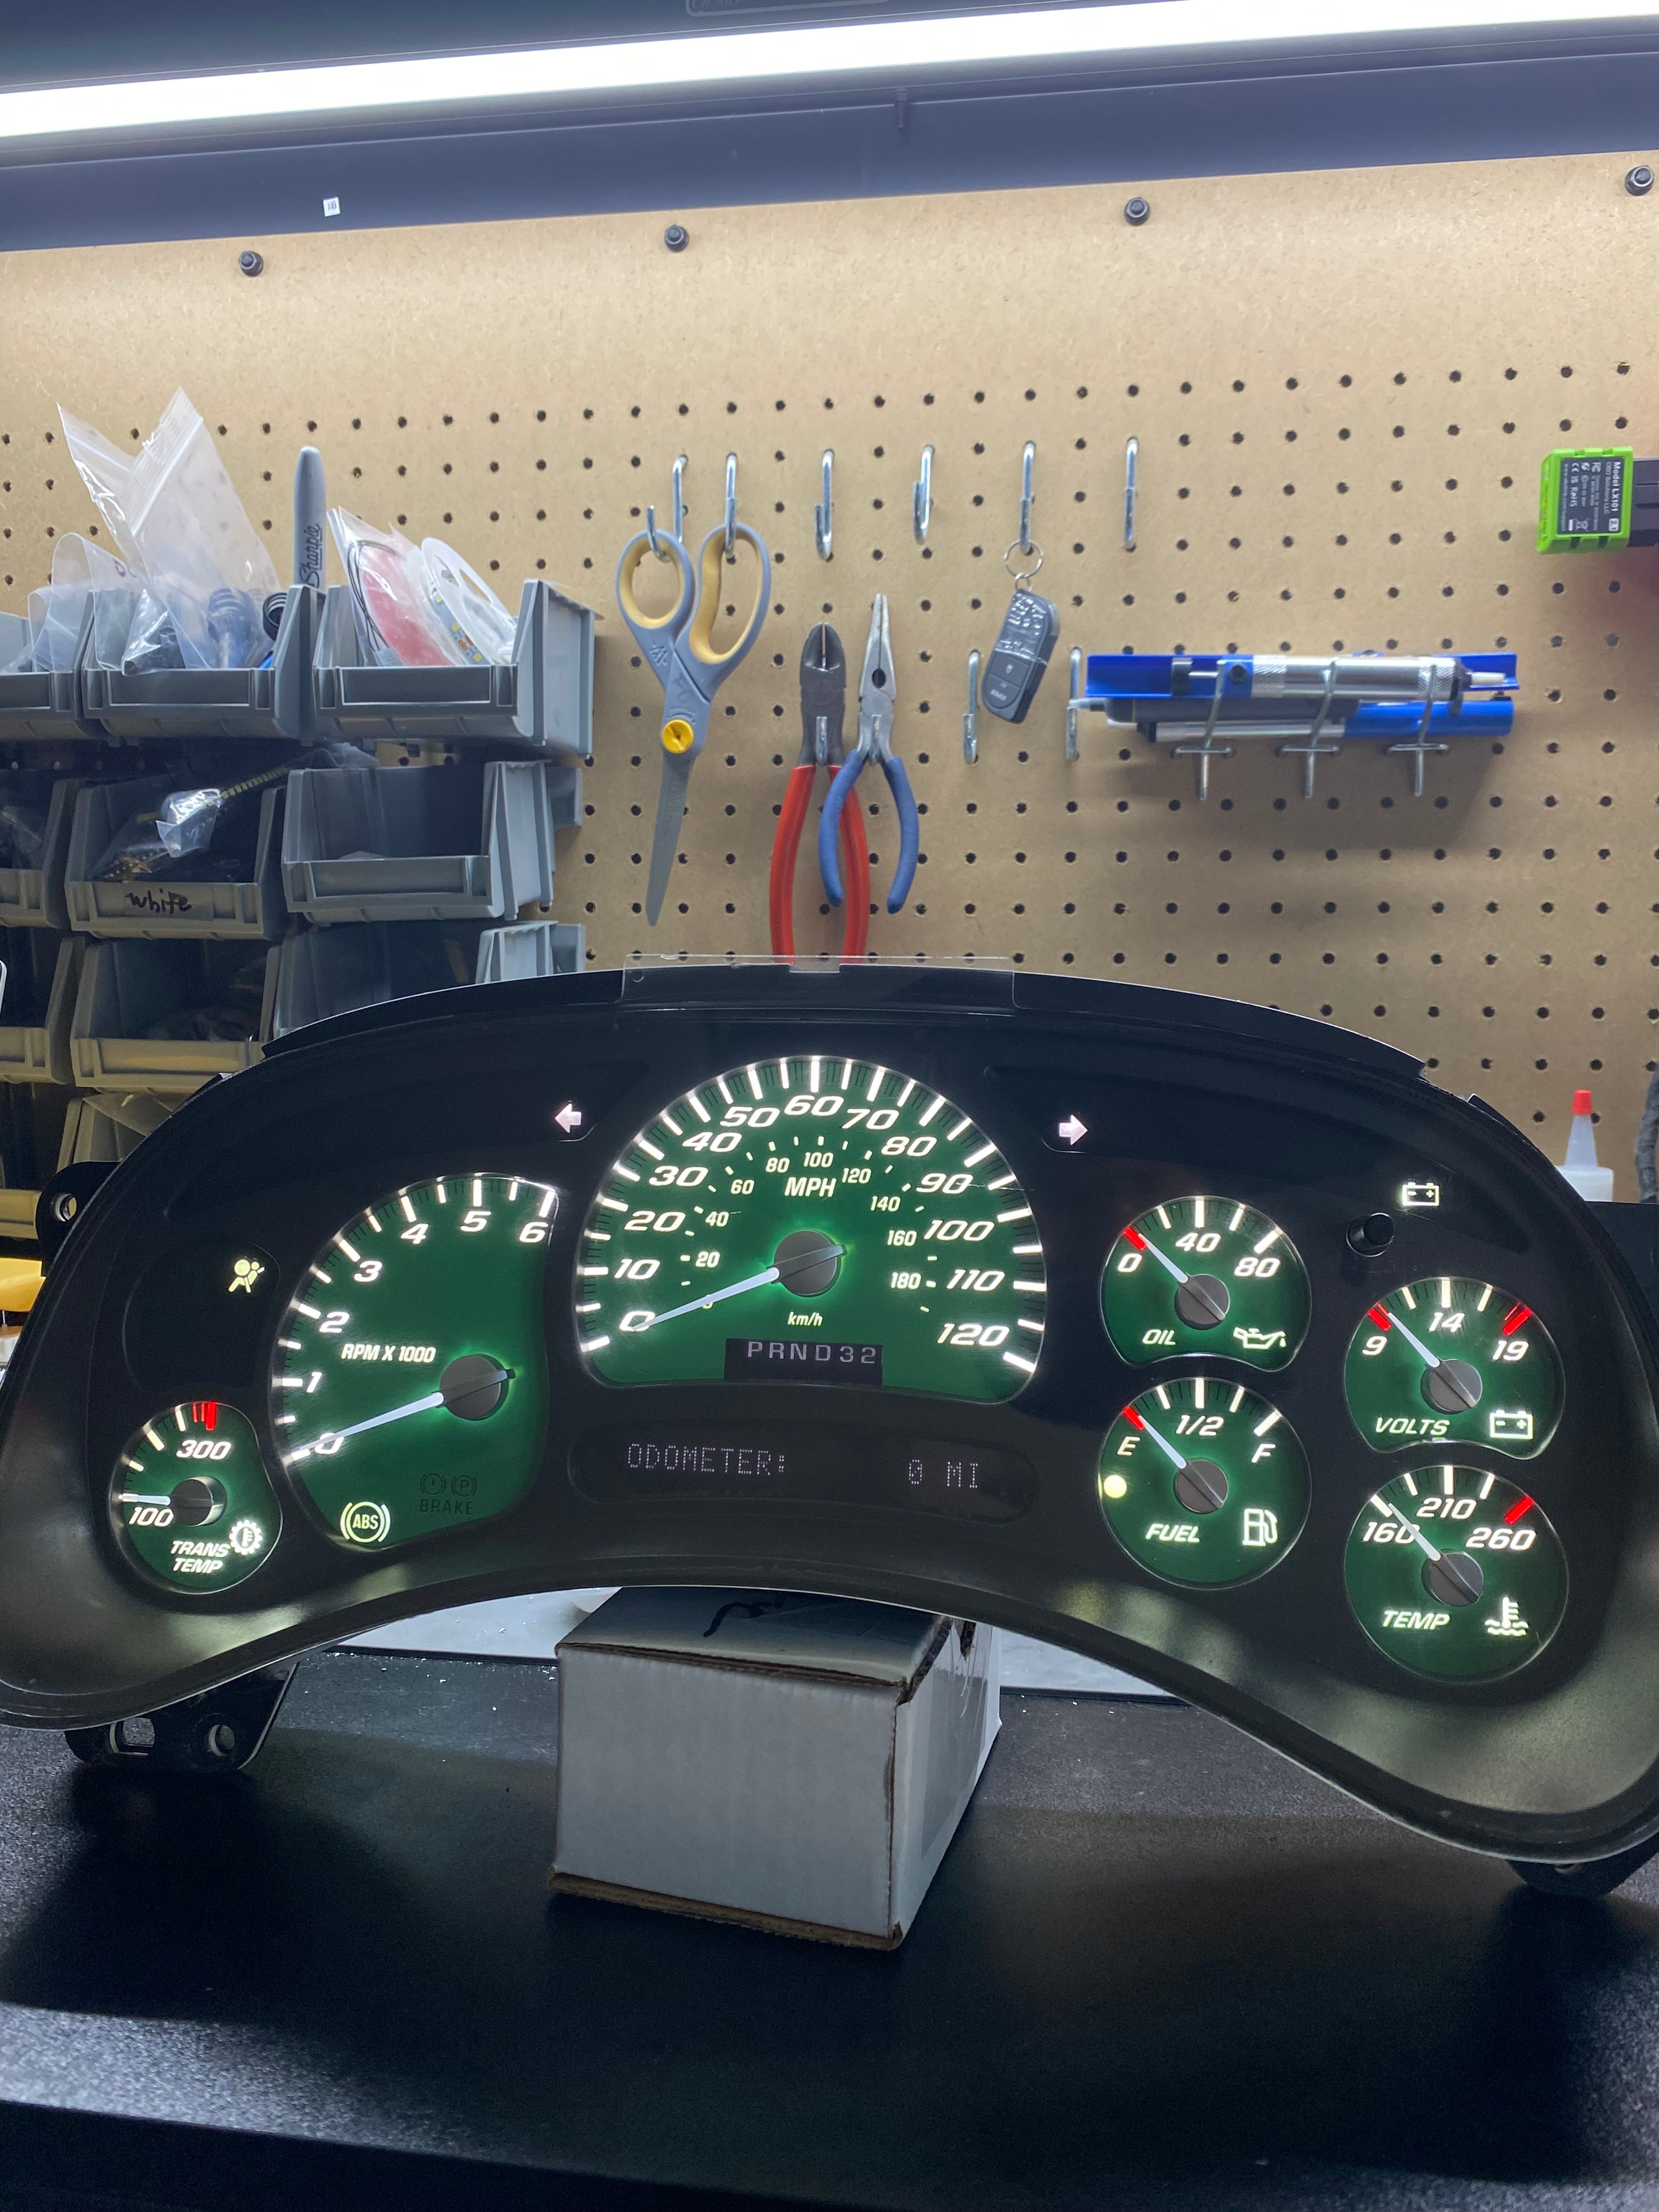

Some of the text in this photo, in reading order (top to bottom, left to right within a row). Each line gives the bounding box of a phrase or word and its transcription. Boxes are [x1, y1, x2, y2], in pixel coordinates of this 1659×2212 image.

[1611, 461, 1621, 511] Model LX101
[299, 523, 322, 588] Sharpie
[783, 1095, 844, 1118] 60
[719, 1106, 780, 1129] 50
[842, 1108, 900, 1130] 70
[682, 1131, 742, 1153] 40
[881, 1136, 937, 1158] 80
[765, 1158, 791, 1174] 80
[804, 1152, 834, 1168] 100
[648, 1165, 708, 1188] 30
[842, 1167, 872, 1184] 120
[915, 1173, 971, 1195] 90
[730, 1178, 755, 1195] 60
[784, 1176, 837, 1198] MPH
[870, 1196, 901, 1212] 140
[460, 1210, 492, 1232] 5
[624, 1210, 685, 1233] 20
[706, 1211, 729, 1228] 40
[400, 1222, 430, 1245] 4
[518, 1221, 549, 1244] 6
[887, 1230, 918, 1246] 160
[924, 1220, 995, 1242] 100
[1175, 1232, 1221, 1252] 40
[613, 1259, 660, 1280] 10
[695, 1252, 720, 1267] 20
[1116, 1252, 1142, 1273] 0
[1234, 1257, 1280, 1277] 80
[353, 1260, 383, 1283] 3
[890, 1273, 922, 1289] 180
[946, 1268, 1005, 1292] 110
[319, 1311, 350, 1334] 2
[619, 1311, 655, 1332] 0
[787, 1311, 823, 1327] km/h
[1427, 1312, 1465, 1333] 14
[936, 1323, 1009, 1346] 120
[1142, 1329, 1176, 1346] OIL
[341, 1343, 437, 1364] RPM X 1000
[1362, 1335, 1387, 1356] 9
[1492, 1340, 1529, 1362] 19
[306, 1372, 323, 1393] 1
[1175, 1415, 1224, 1436] 1/2
[1375, 1417, 1449, 1436] VOLTS
[176, 1440, 232, 1460] 300
[1117, 1436, 1140, 1456] E
[1251, 1443, 1276, 1463] F
[628, 1443, 785, 1475] ODOMETER:
[948, 1462, 978, 1488] MI
[128, 1506, 174, 1527] 100
[420, 1499, 473, 1515] BRAKE
[1417, 1498, 1477, 1520] 210
[352, 1514, 379, 1531] ABS
[1363, 1522, 1420, 1544] 160
[1146, 1524, 1200, 1543] FUEL
[1466, 1528, 1536, 1551] 260
[170, 1541, 232, 1558] TRANS
[172, 1557, 224, 1575] TEMP
[1383, 1611, 1449, 1629] TEMP
